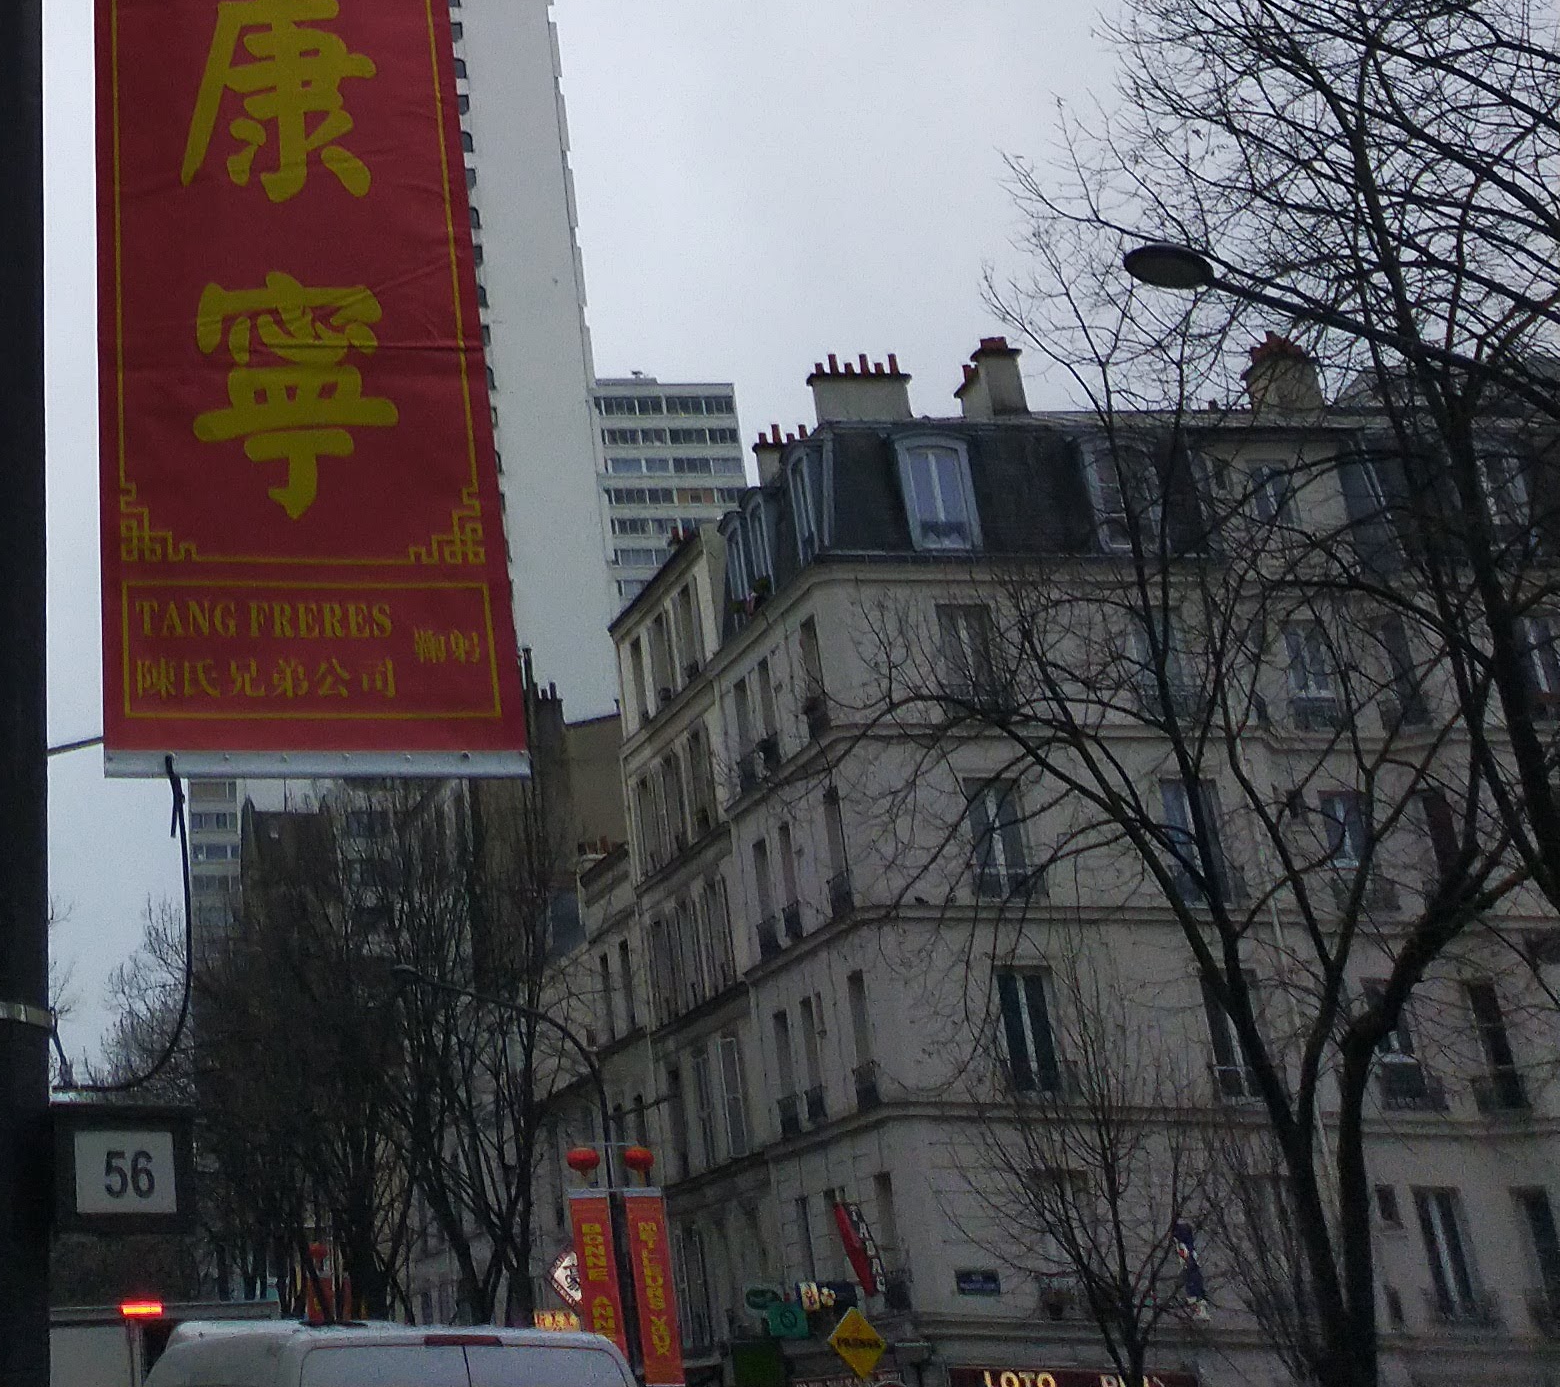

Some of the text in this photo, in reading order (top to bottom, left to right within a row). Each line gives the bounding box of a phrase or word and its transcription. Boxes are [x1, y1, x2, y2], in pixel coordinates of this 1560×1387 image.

[136, 599, 393, 639] TANG FRERES
[136, 657, 397, 699] 陳氏兄弟公司
[104, 1149, 156, 1199] 56
